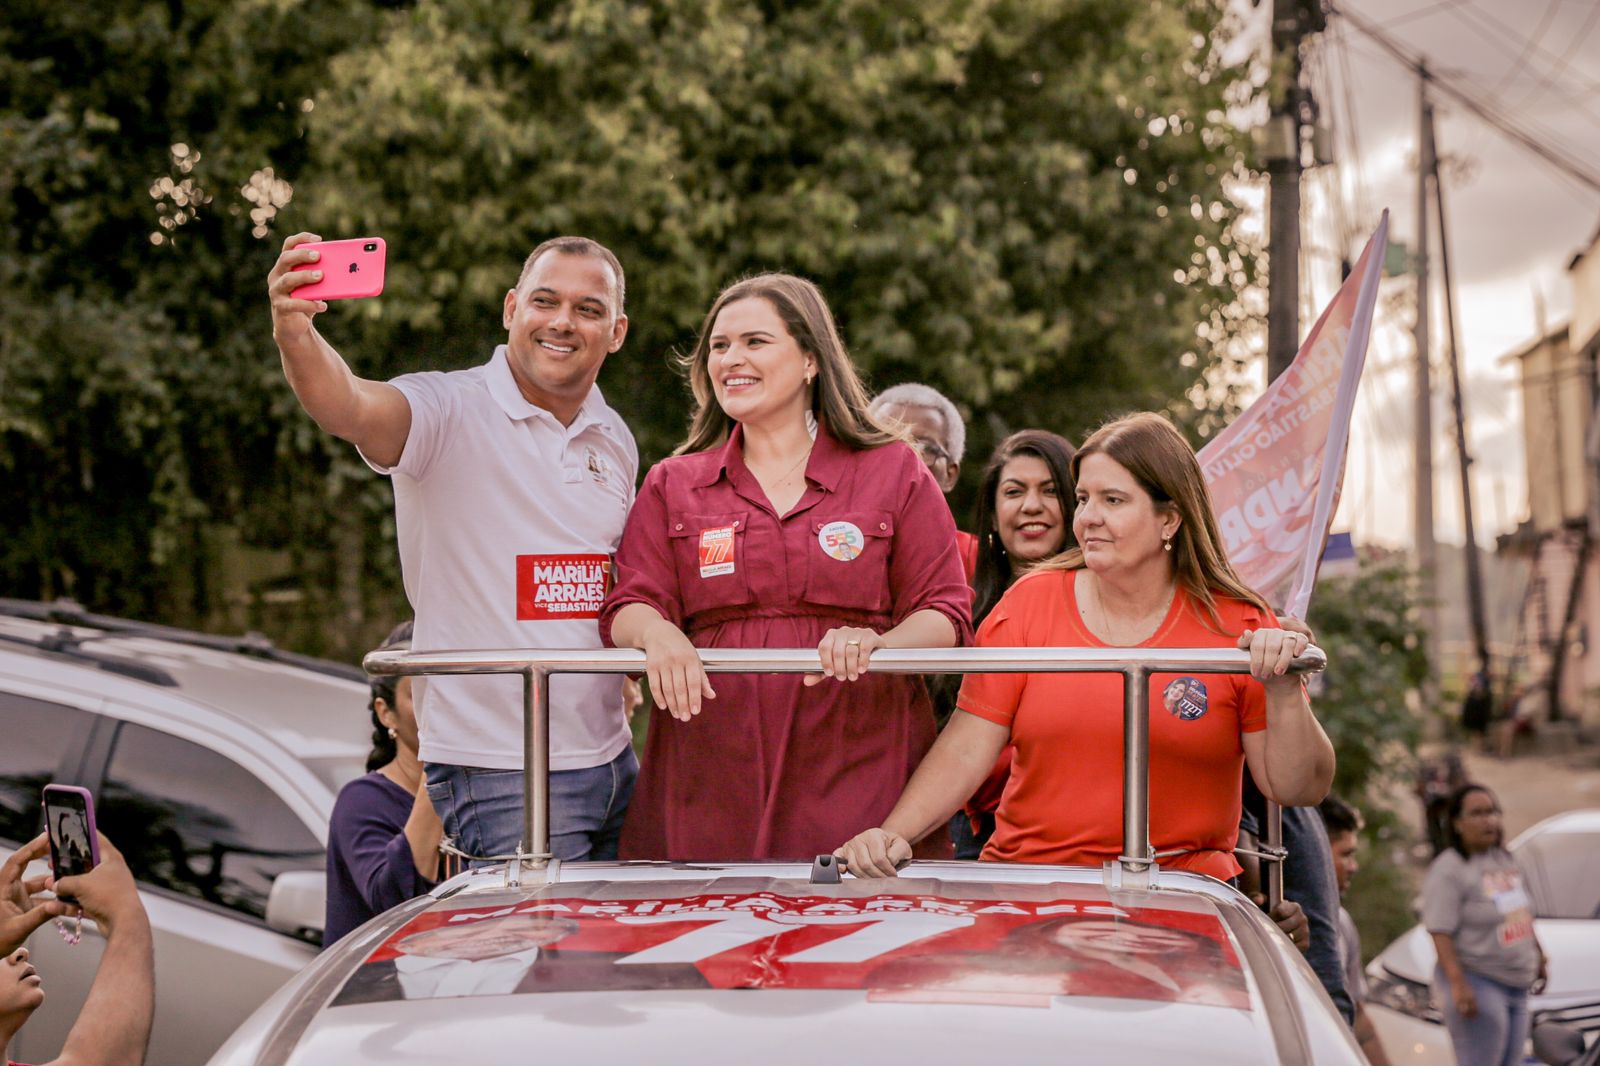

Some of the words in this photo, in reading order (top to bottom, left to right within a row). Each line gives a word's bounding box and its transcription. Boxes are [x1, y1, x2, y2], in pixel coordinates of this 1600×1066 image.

[702, 537, 732, 564] 77
[534, 583, 604, 602] ARRAES
[803, 900, 1130, 917] ARRAES
[613, 910, 976, 964] 77
